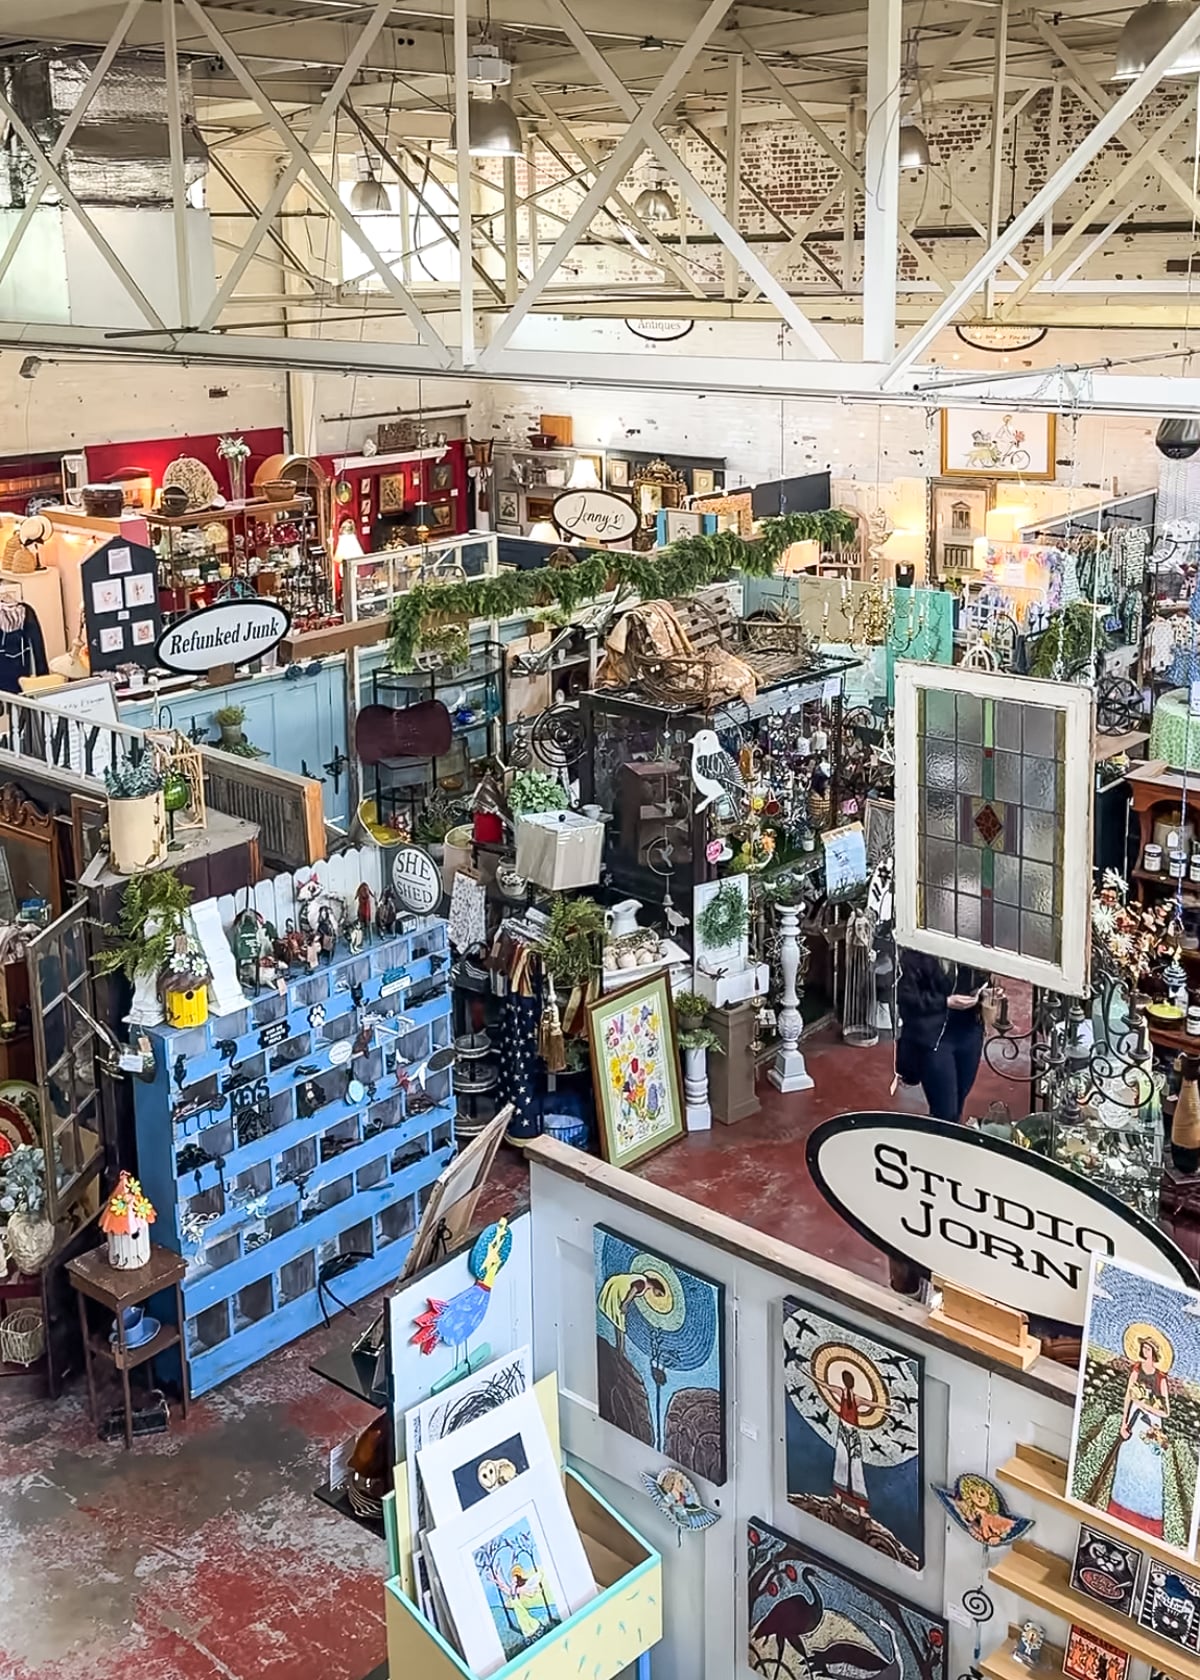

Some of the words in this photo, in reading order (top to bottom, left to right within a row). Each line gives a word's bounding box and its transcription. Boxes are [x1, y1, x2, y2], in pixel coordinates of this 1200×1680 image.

[638, 318, 681, 332] Antiques
[566, 495, 625, 533] Jenny's
[169, 622, 240, 656] Refunked
[243, 616, 280, 642] Junk
[396, 851, 431, 881] SHE
[396, 881, 433, 904] SHED
[874, 1142, 1116, 1257] STUDIO
[901, 1199, 1083, 1290] JORN
